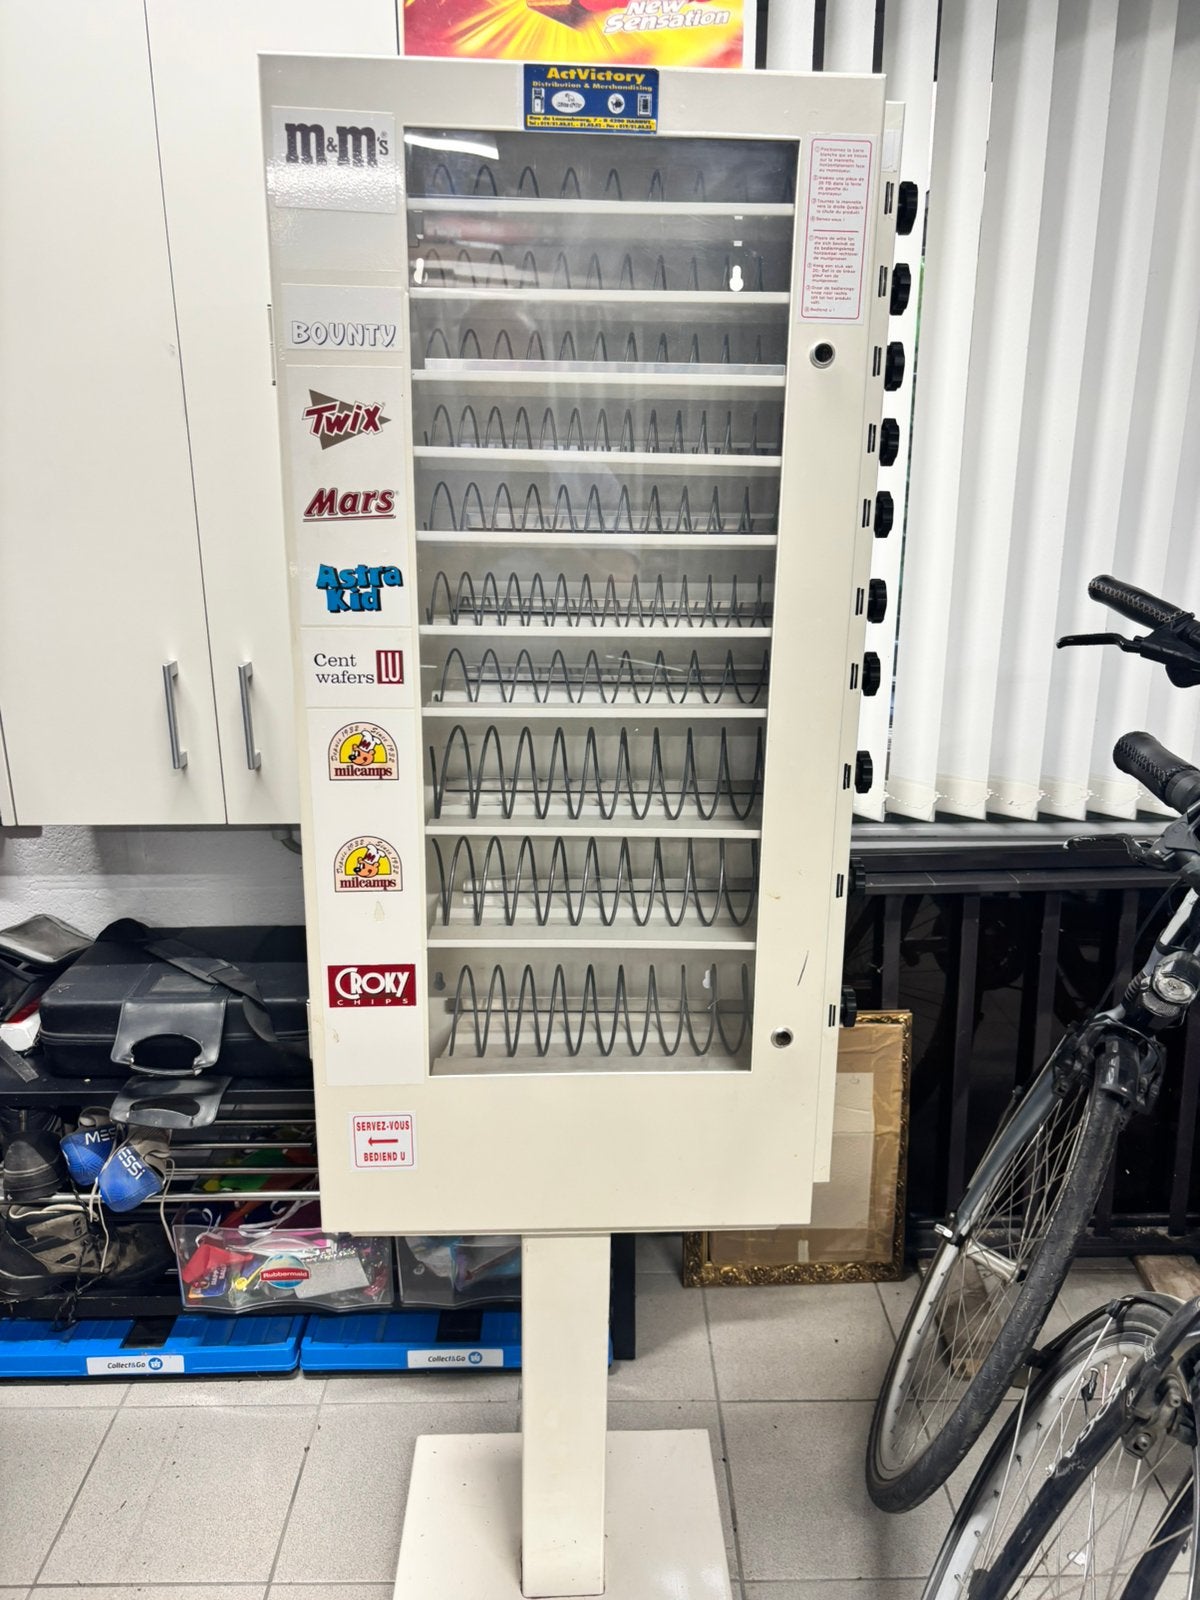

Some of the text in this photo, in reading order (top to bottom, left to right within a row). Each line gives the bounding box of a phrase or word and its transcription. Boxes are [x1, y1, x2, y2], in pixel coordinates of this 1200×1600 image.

[626, 0, 685, 15] New
[604, 9, 730, 33] Sensation
[547, 67, 646, 84] ActVictory
[532, 81, 581, 89] Distribution
[592, 82, 653, 92] Merchandising
[292, 321, 396, 347] BOUNTY
[304, 487, 395, 517] Mars
[316, 564, 403, 589] Astra
[327, 587, 381, 613] Kid
[313, 653, 357, 667] Cent
[380, 652, 402, 683] LU
[315, 670, 375, 684] wafers
[334, 765, 393, 779] milcamps
[340, 877, 396, 891] milcamps
[335, 967, 409, 999] CROKY
[337, 998, 408, 1006] CHIPS
[356, 1121, 410, 1131] SERVEZ-VOUS
[364, 1152, 406, 1162] BEDIEND U
[262, 1271, 308, 1279] Rubbermaid
